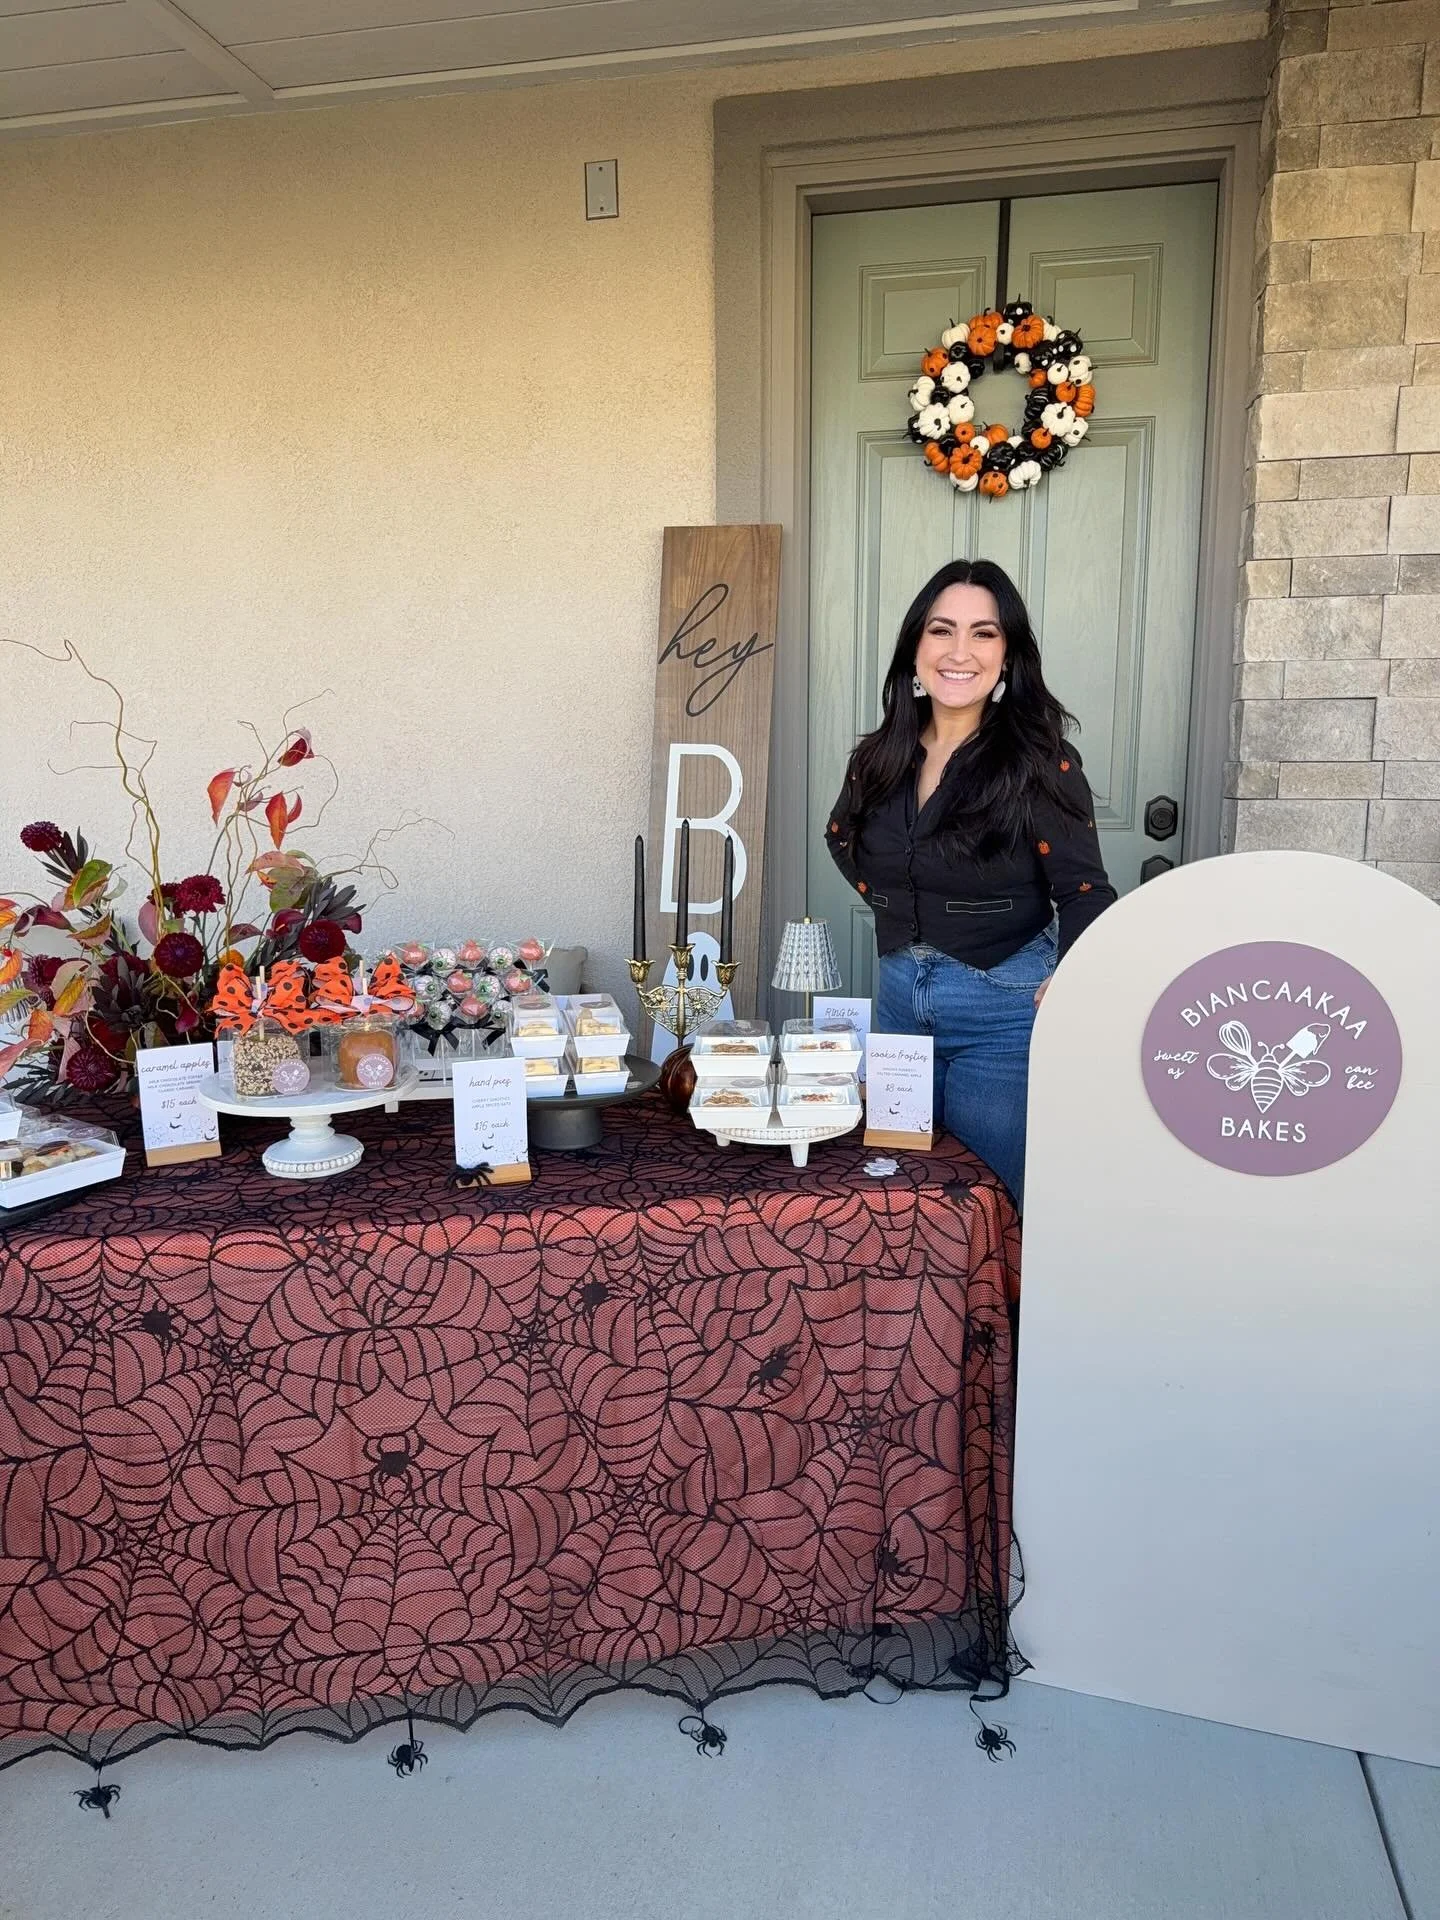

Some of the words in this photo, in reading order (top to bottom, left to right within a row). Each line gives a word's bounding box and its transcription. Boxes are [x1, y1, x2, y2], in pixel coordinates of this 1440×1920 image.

[657, 582, 775, 718] hey
[1180, 979, 1368, 1040] BIANCAAKAA
[870, 1049, 897, 1060] cookie
[1153, 1049, 1200, 1064] sweet
[141, 1059, 178, 1073] caramel
[180, 1056, 210, 1072] apples
[1344, 1063, 1378, 1076] can
[1167, 1066, 1185, 1080] as
[468, 1074, 492, 1088] hand
[885, 1083, 895, 1093] $8
[897, 1084, 913, 1093] each
[1346, 1075, 1375, 1090] bee
[161, 1098, 176, 1110] $15
[178, 1096, 198, 1106] each
[491, 1117, 509, 1129] each
[1220, 1116, 1307, 1143] BAKES
